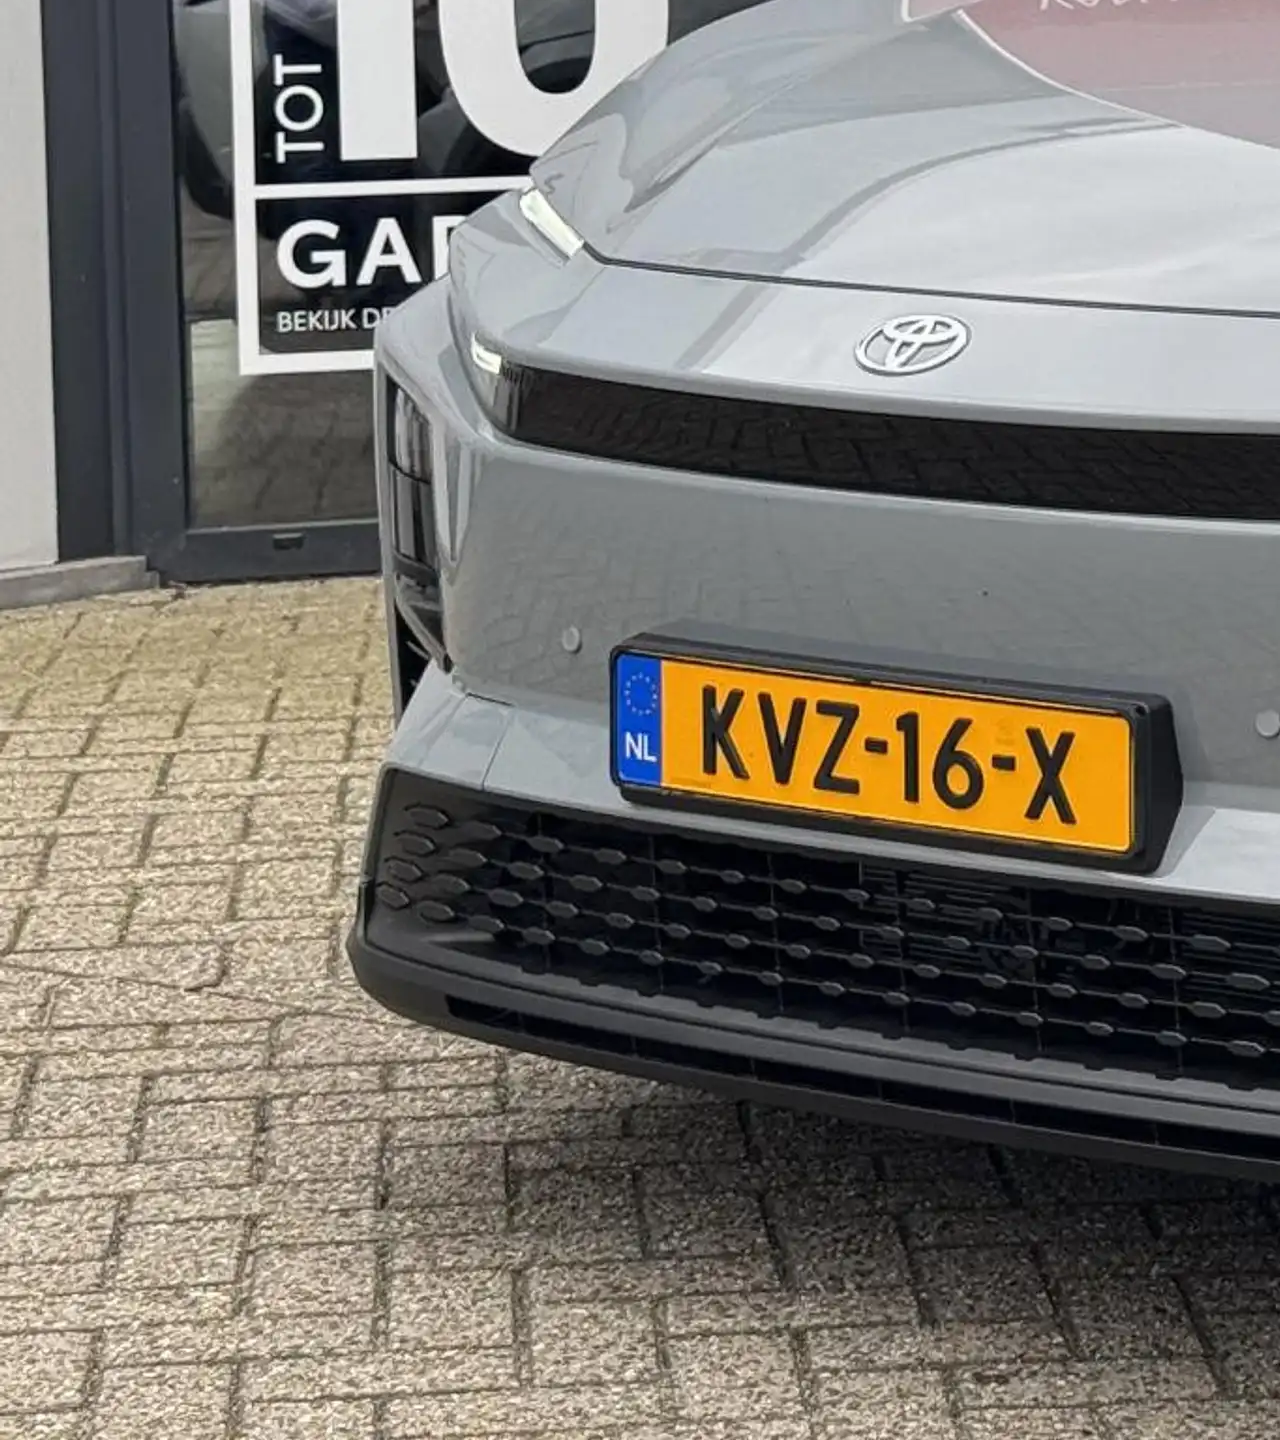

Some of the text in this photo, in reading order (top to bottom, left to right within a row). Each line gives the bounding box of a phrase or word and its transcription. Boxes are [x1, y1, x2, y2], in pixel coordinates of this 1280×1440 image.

[275, 54, 324, 164] TOT
[277, 307, 357, 333] BEKIJK
[625, 731, 657, 763] NL
[702, 684, 1077, 825] KVZ-16-X
